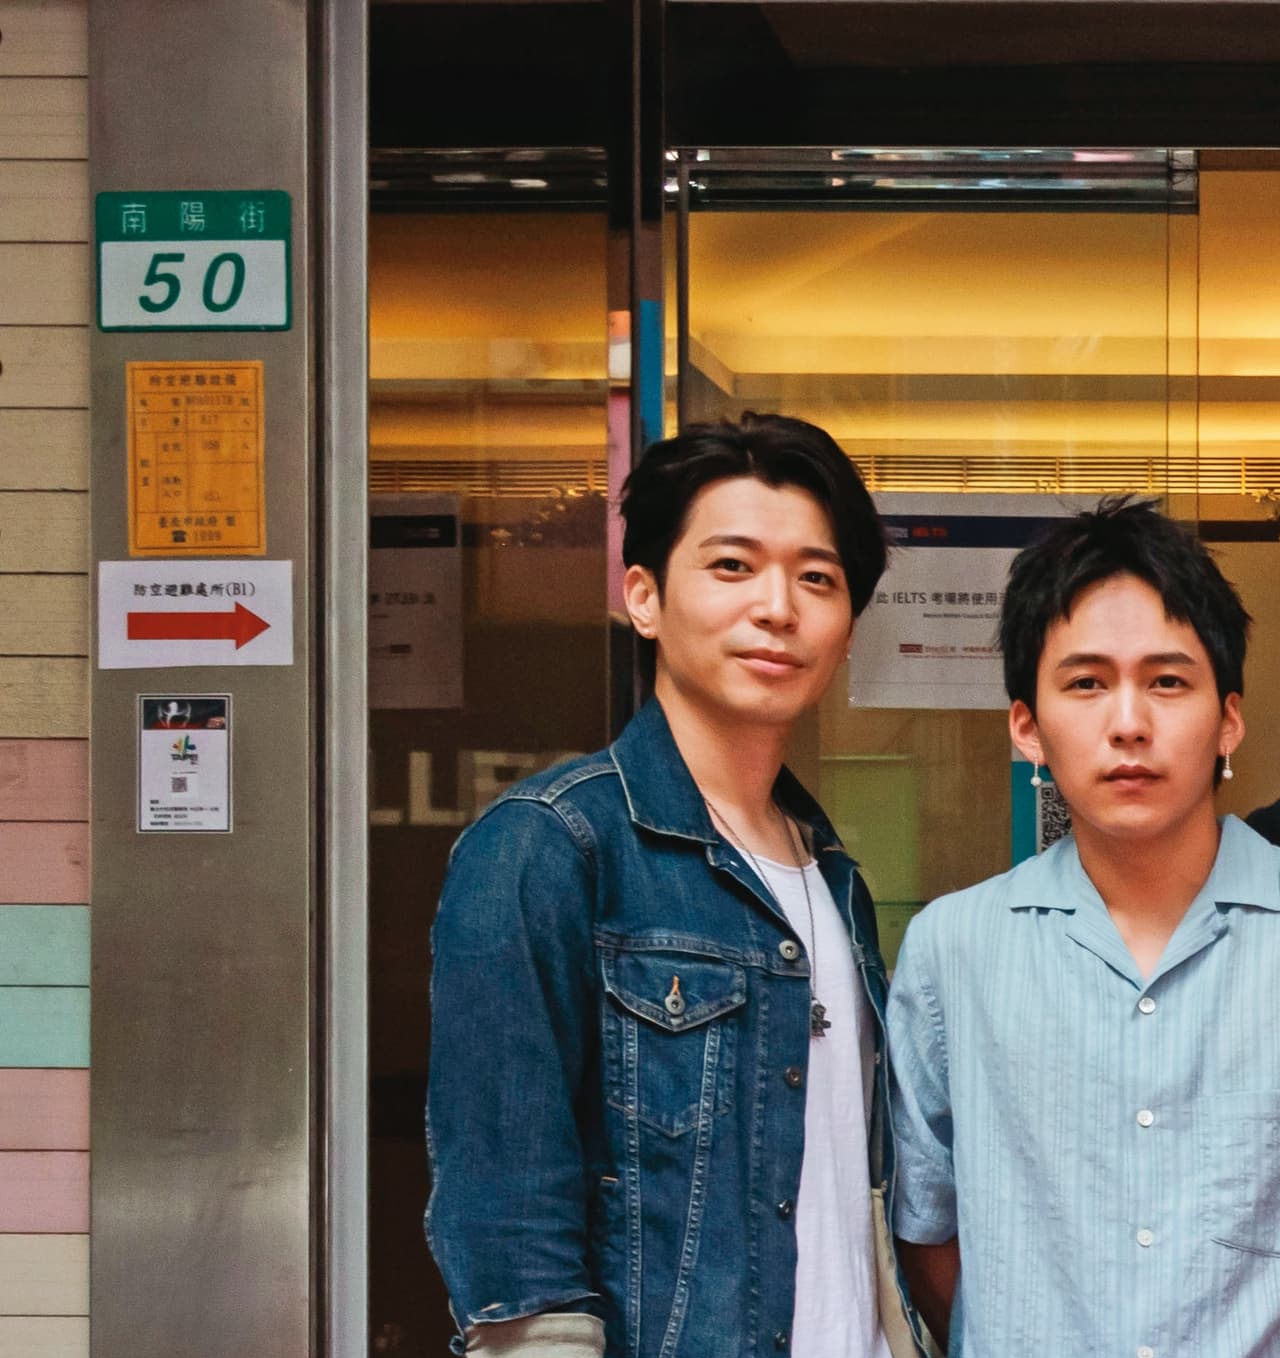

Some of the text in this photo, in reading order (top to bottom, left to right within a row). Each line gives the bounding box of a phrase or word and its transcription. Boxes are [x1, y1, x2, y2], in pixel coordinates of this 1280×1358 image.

[120, 202, 265, 233] 南陽街
[139, 253, 245, 312] 50
[892, 592, 927, 604] IELTS
